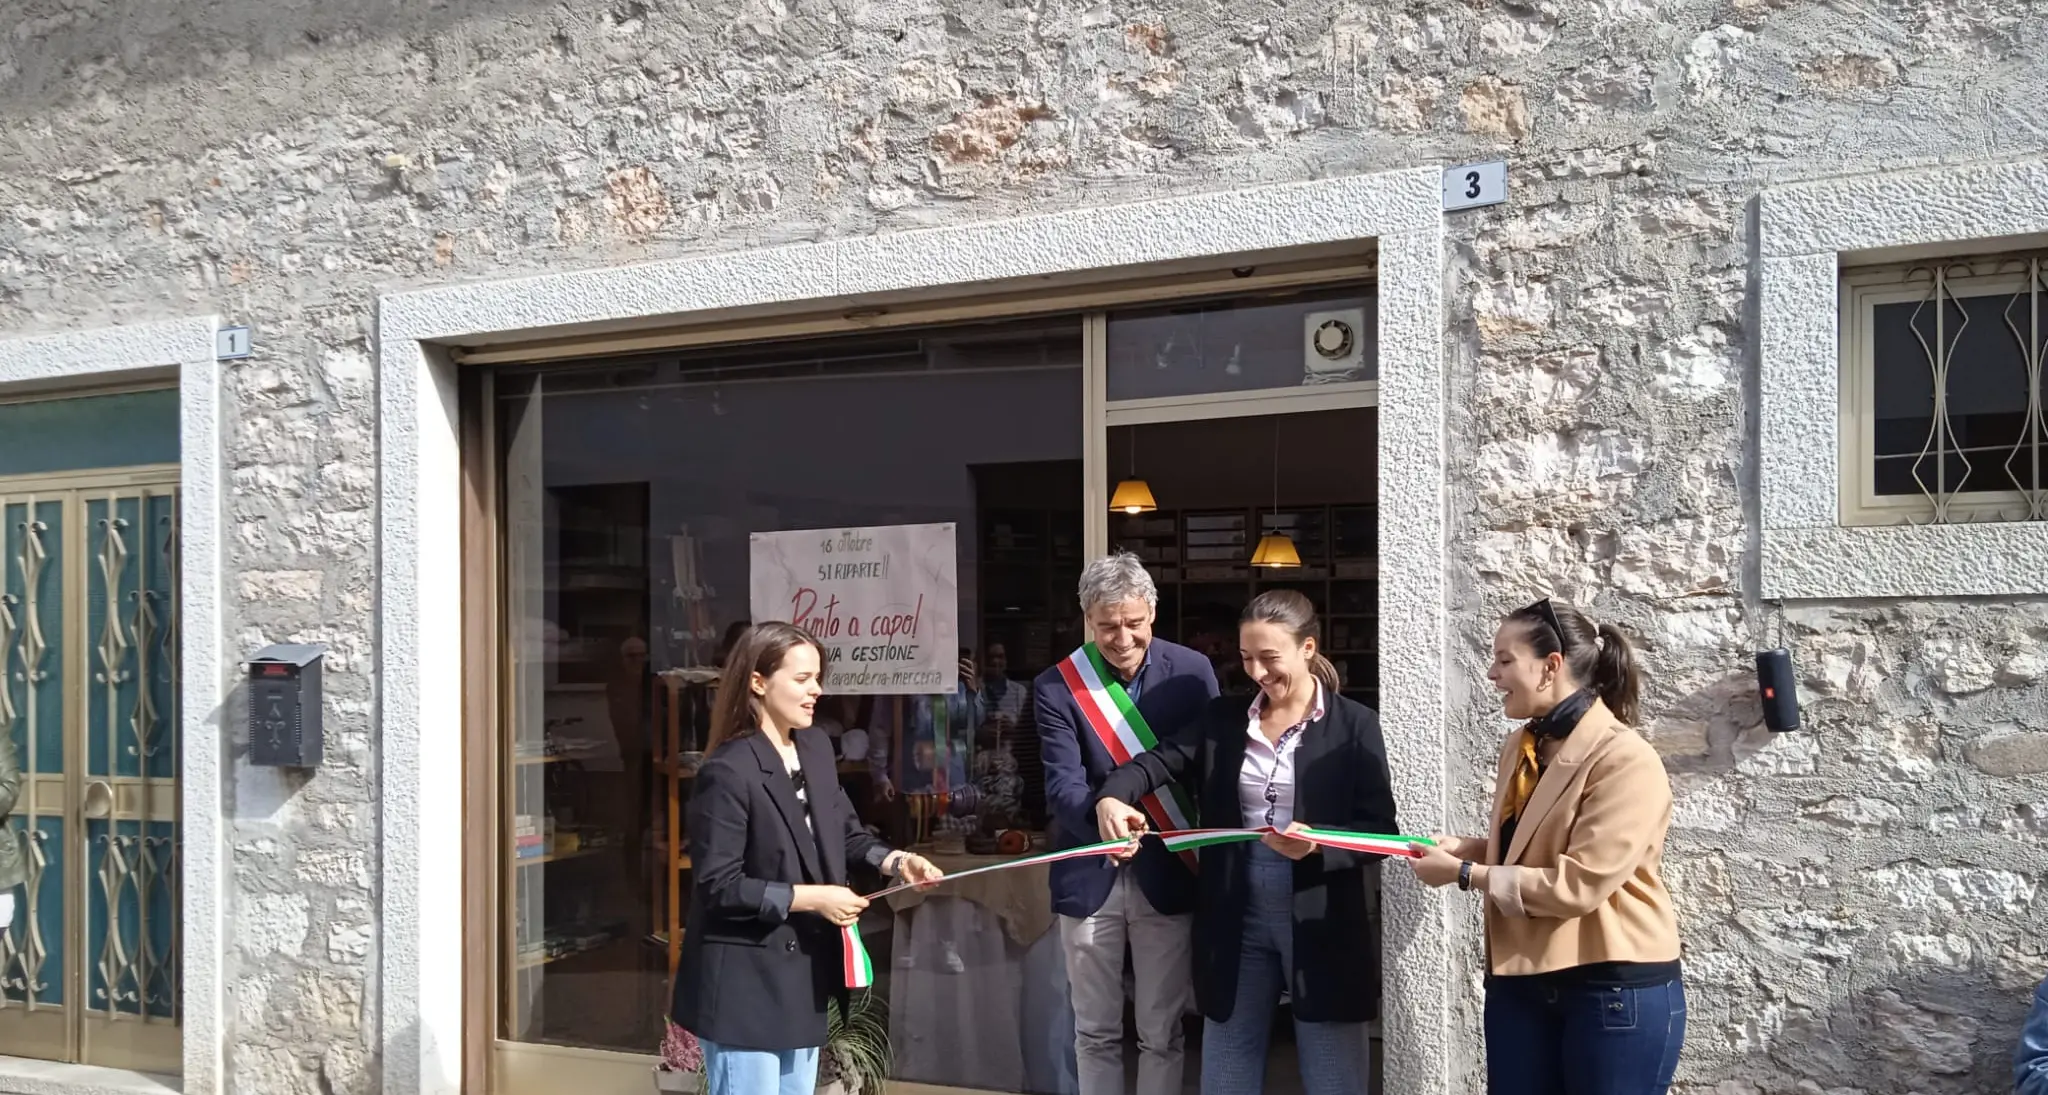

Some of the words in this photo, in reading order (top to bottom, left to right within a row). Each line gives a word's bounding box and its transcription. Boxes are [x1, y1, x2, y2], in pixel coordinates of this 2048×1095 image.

[1465, 171, 1481, 199] 3
[228, 333, 236, 353] 1
[820, 539, 833, 554] 16
[818, 564, 833, 581] SI
[848, 616, 861, 637] a
[870, 593, 924, 649] capo!
[851, 645, 920, 662] GESTIONE
